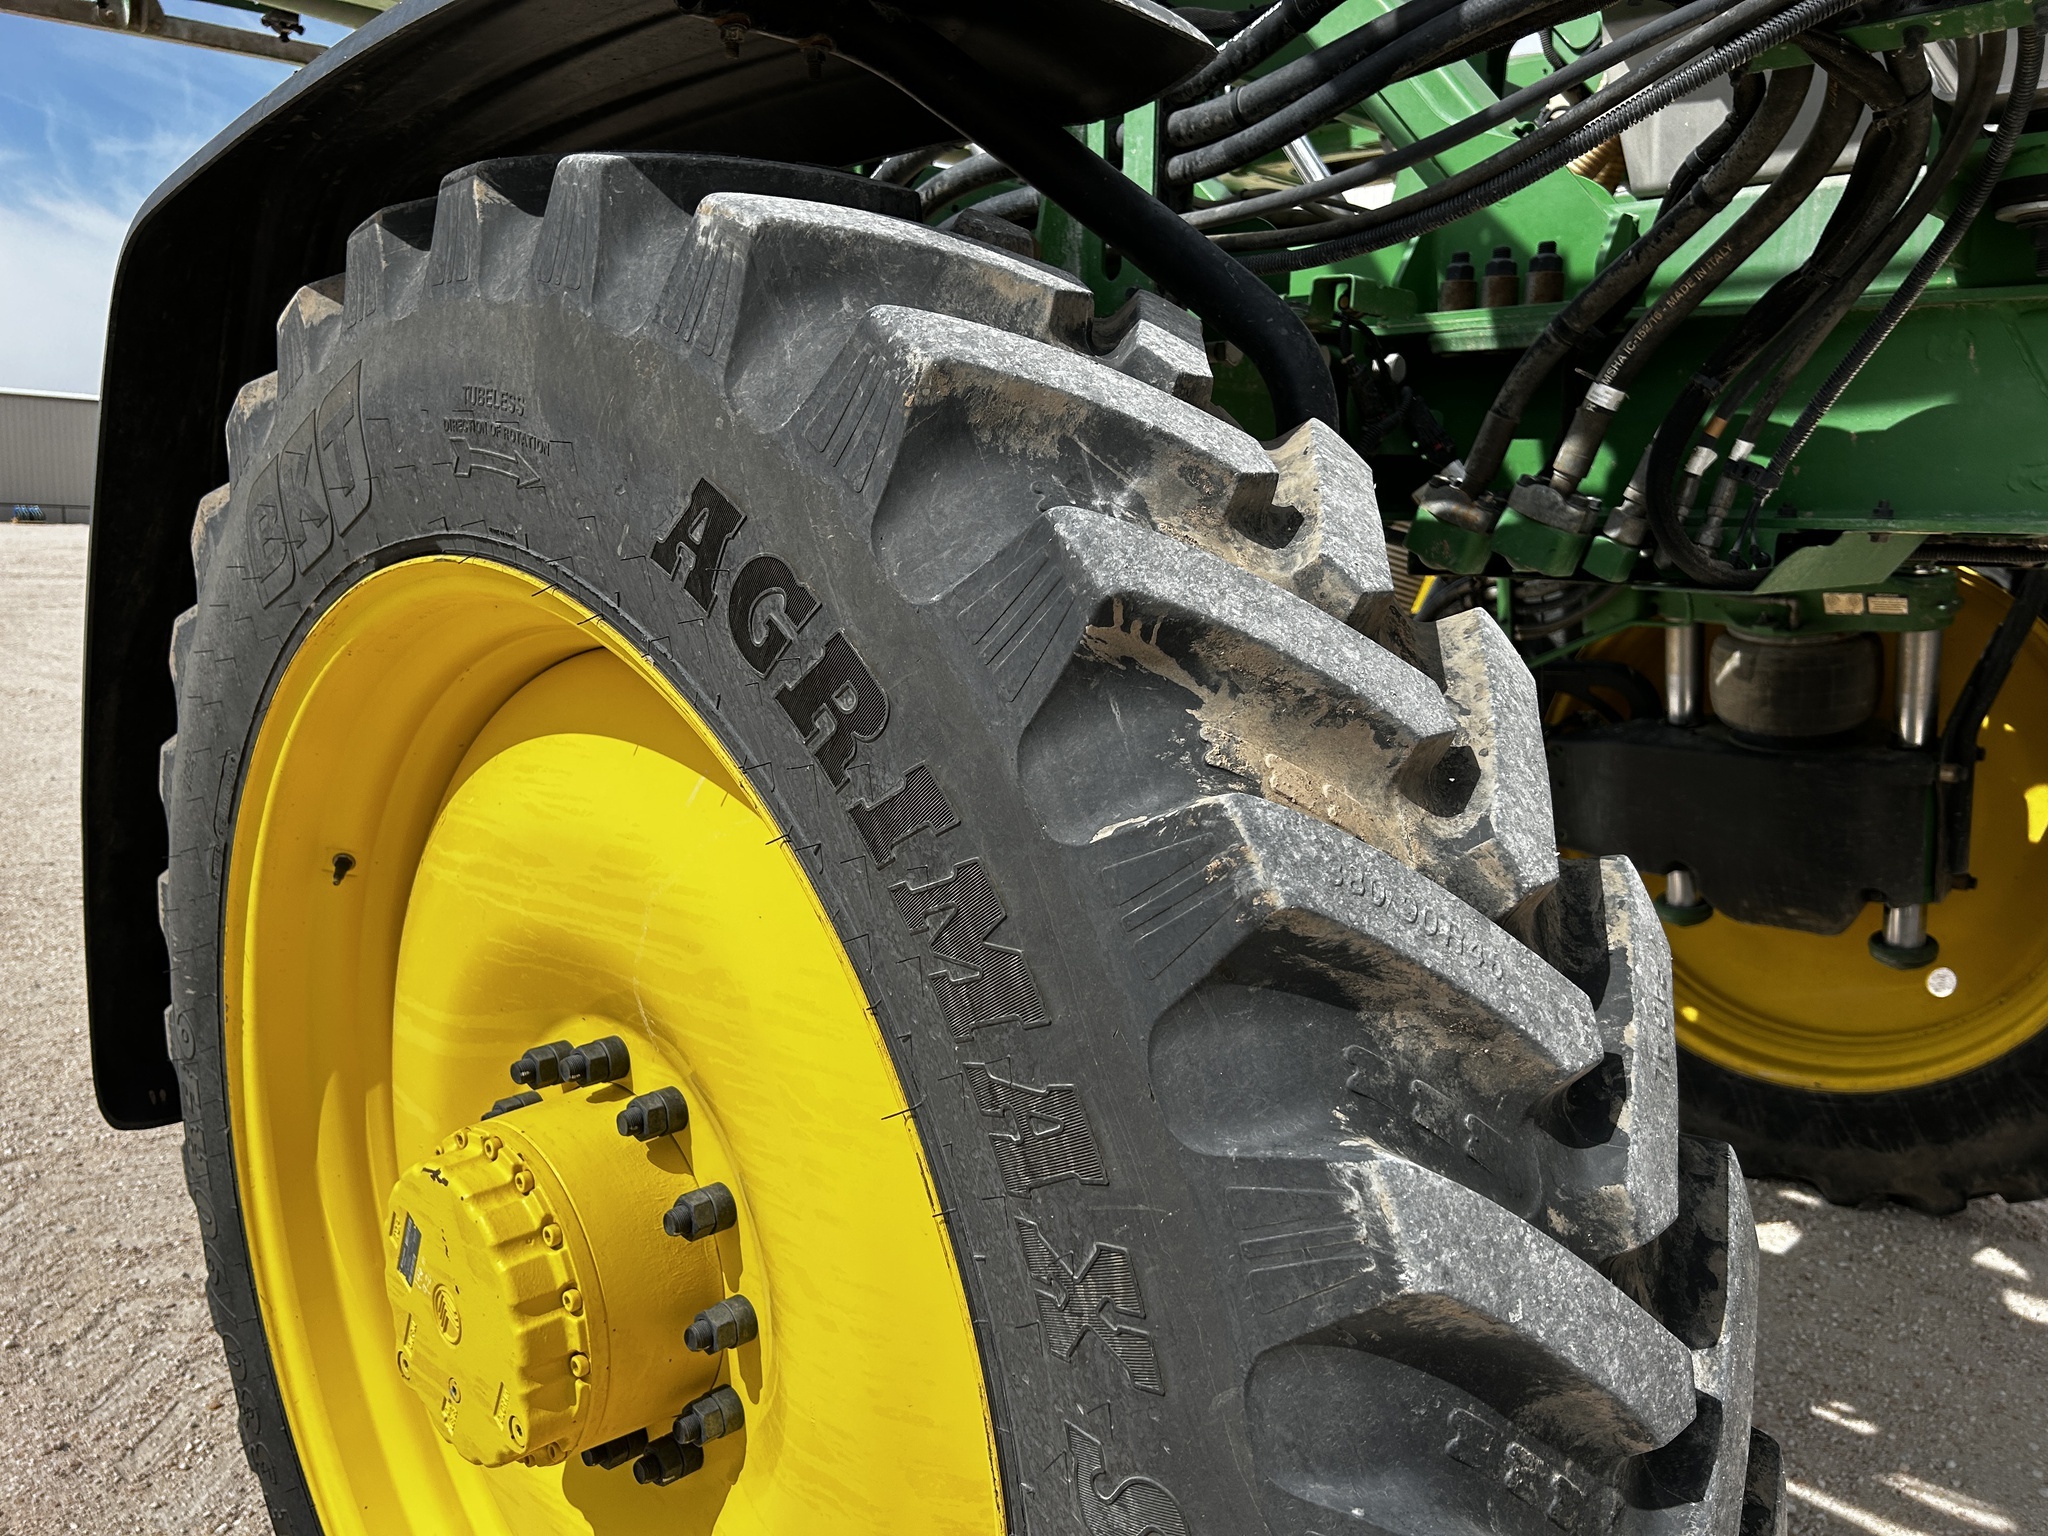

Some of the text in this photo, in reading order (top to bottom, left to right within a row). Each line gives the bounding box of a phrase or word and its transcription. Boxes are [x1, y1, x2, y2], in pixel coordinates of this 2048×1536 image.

[1601, 354, 1628, 386] MSHA
[1626, 310, 1663, 356] IC-152/16
[1665, 276, 1697, 309] MADE
[1693, 264, 1708, 285] IN
[1704, 241, 1734, 273] ITALY
[442, 416, 551, 457] DIRECTION OF ROTATION
[461, 384, 526, 417] TUBELESS
[649, 477, 1167, 1396] AGRIMAX
